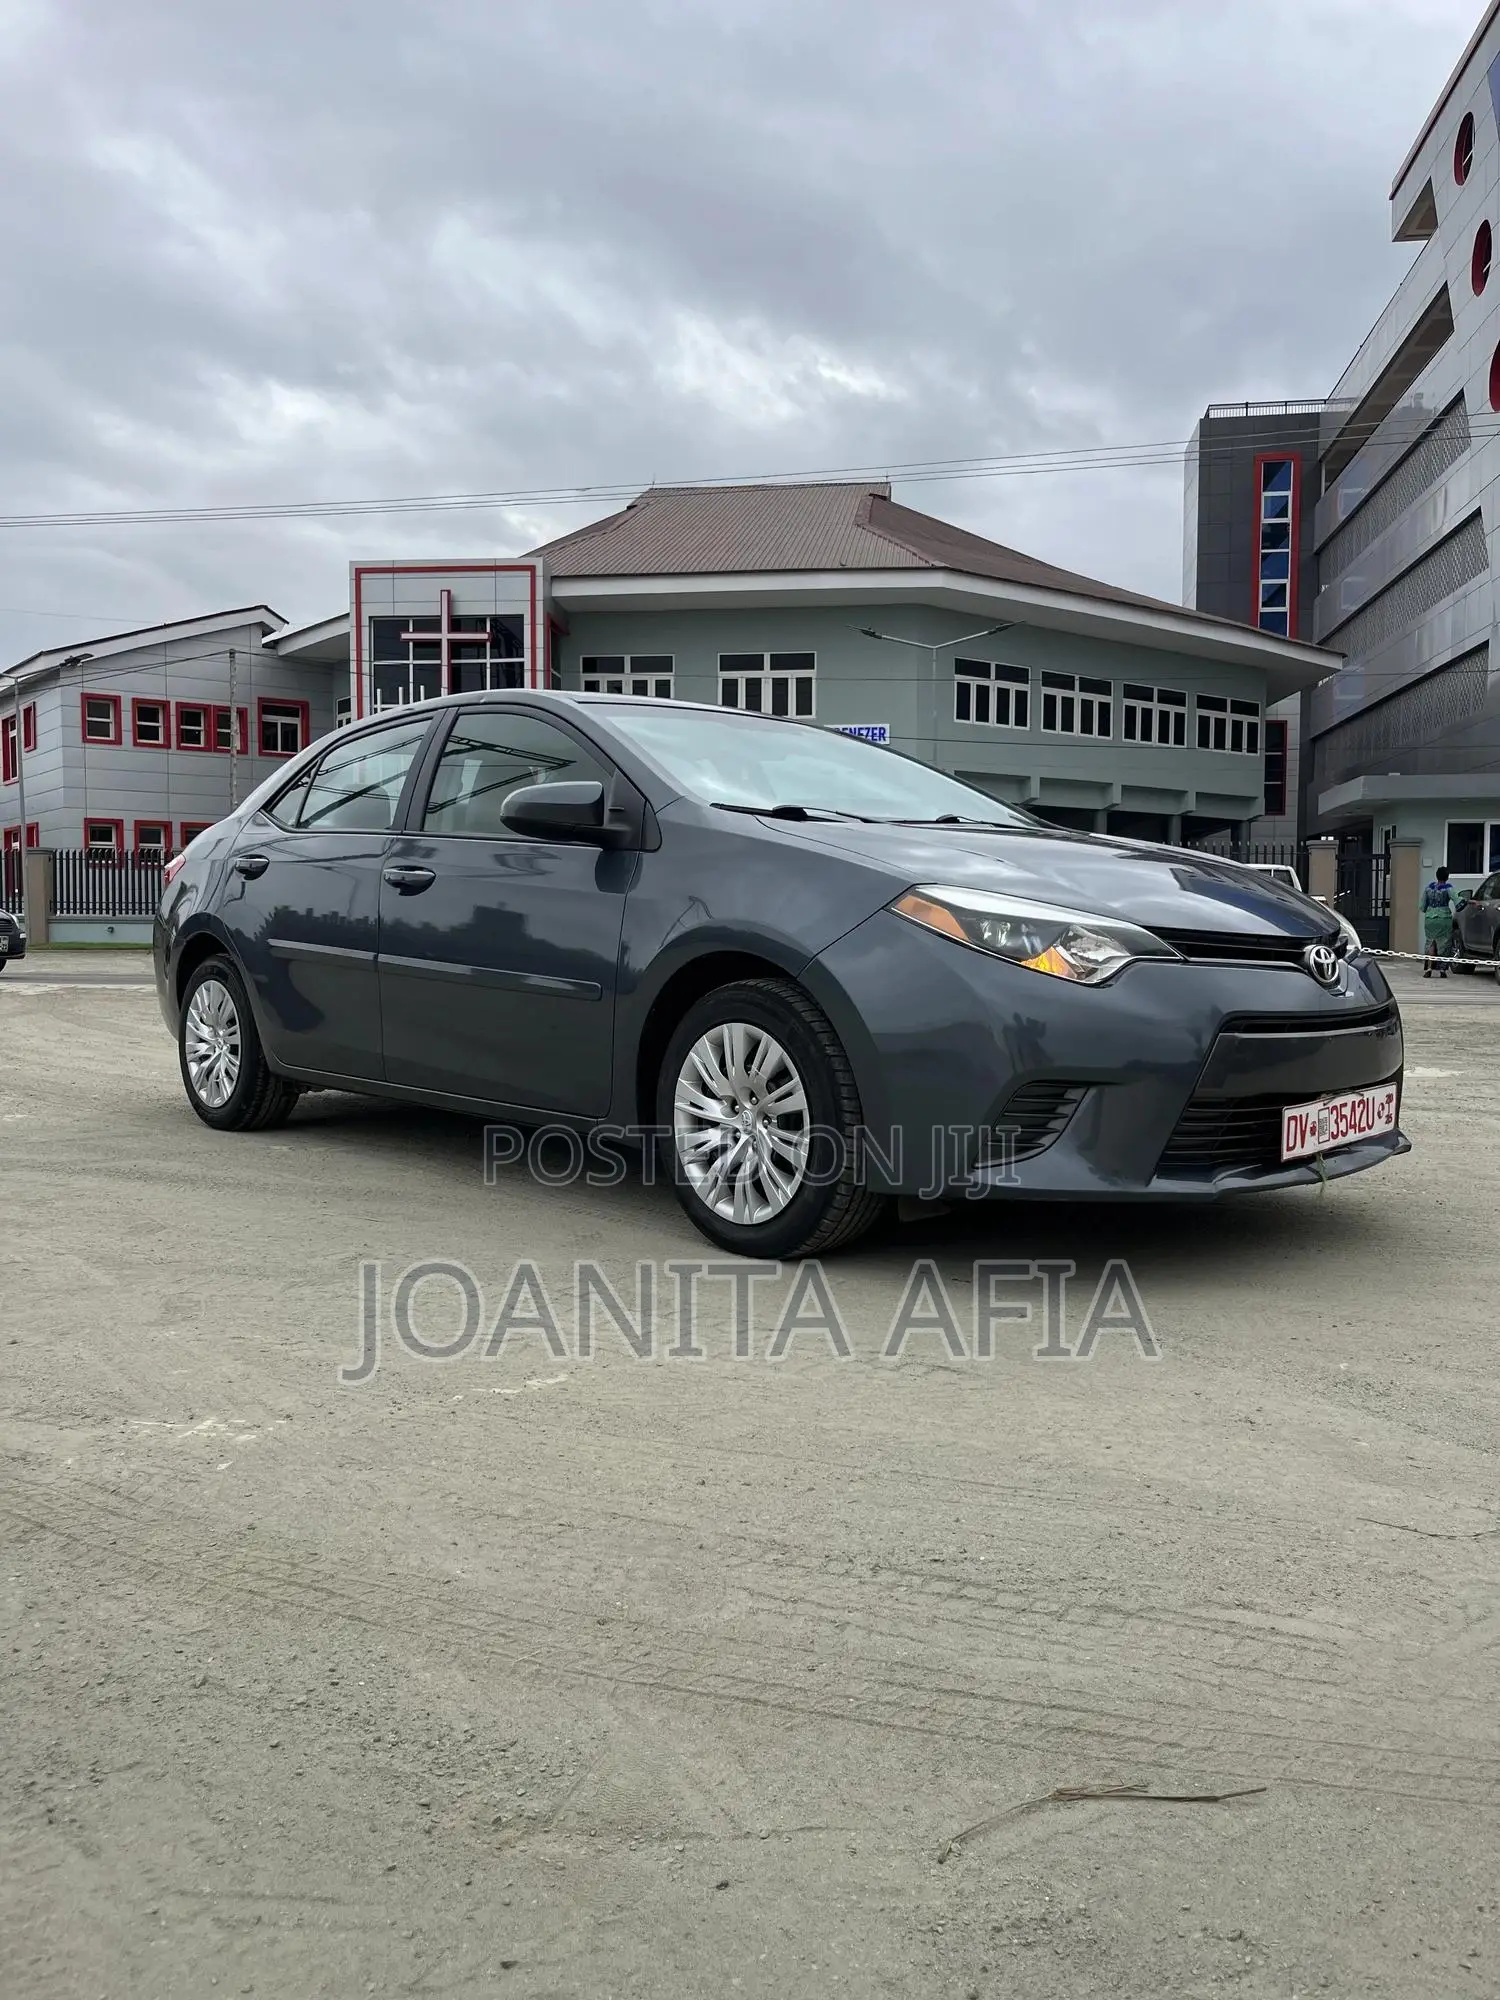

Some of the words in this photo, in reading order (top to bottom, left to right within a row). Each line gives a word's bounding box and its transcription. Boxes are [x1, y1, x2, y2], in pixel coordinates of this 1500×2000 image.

[833, 726, 887, 742] NEZER
[1286, 1112, 1309, 1152] DV
[1330, 1096, 1375, 1140] 3542U
